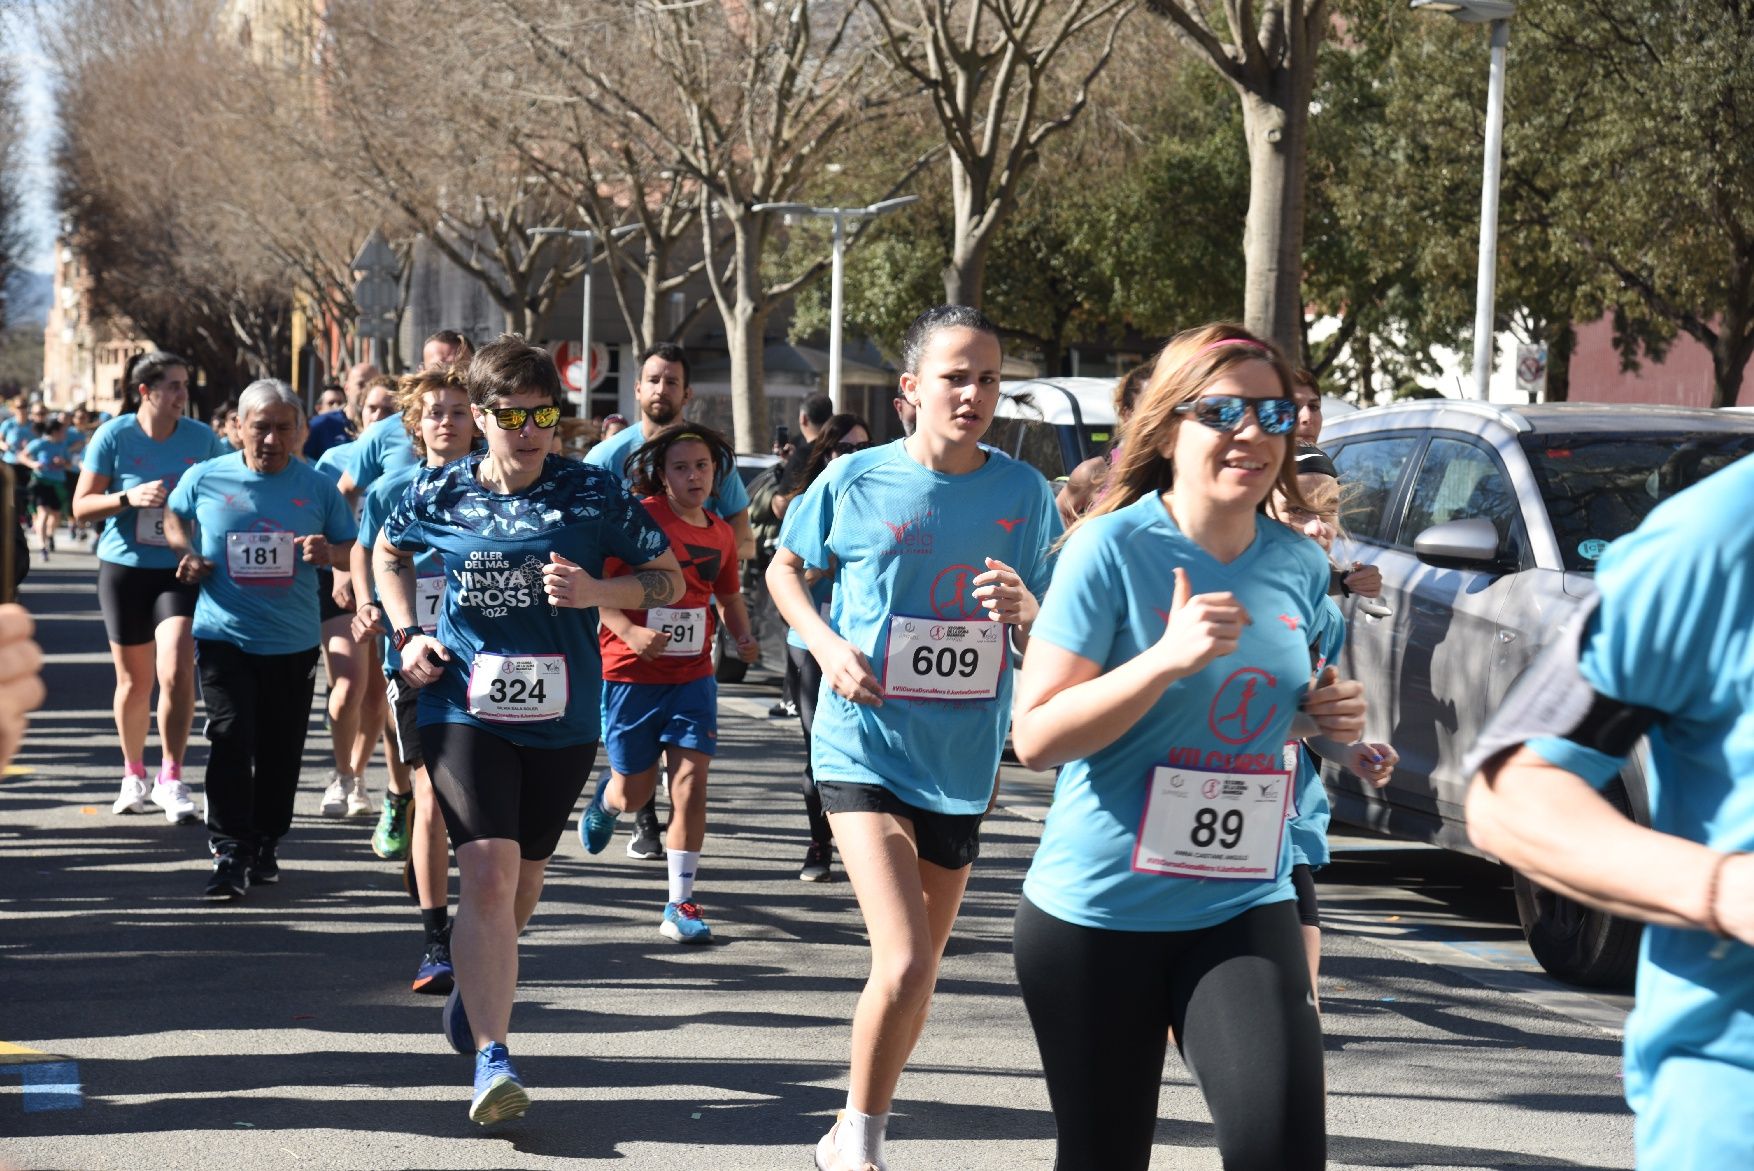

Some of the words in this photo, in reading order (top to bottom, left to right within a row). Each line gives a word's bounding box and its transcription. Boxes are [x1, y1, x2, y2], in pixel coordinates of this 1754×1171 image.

[155, 521, 164, 535] 9
[241, 547, 277, 565] 181
[465, 561, 484, 569] DEL
[486, 561, 510, 569] MAS
[470, 551, 503, 560] OLLER
[453, 569, 526, 589] VINYA
[425, 595, 440, 615] 7
[457, 589, 531, 608] CROSS
[661, 624, 694, 643] 591
[912, 646, 979, 677] 609
[489, 678, 547, 704] 324
[1190, 807, 1244, 849] 89
